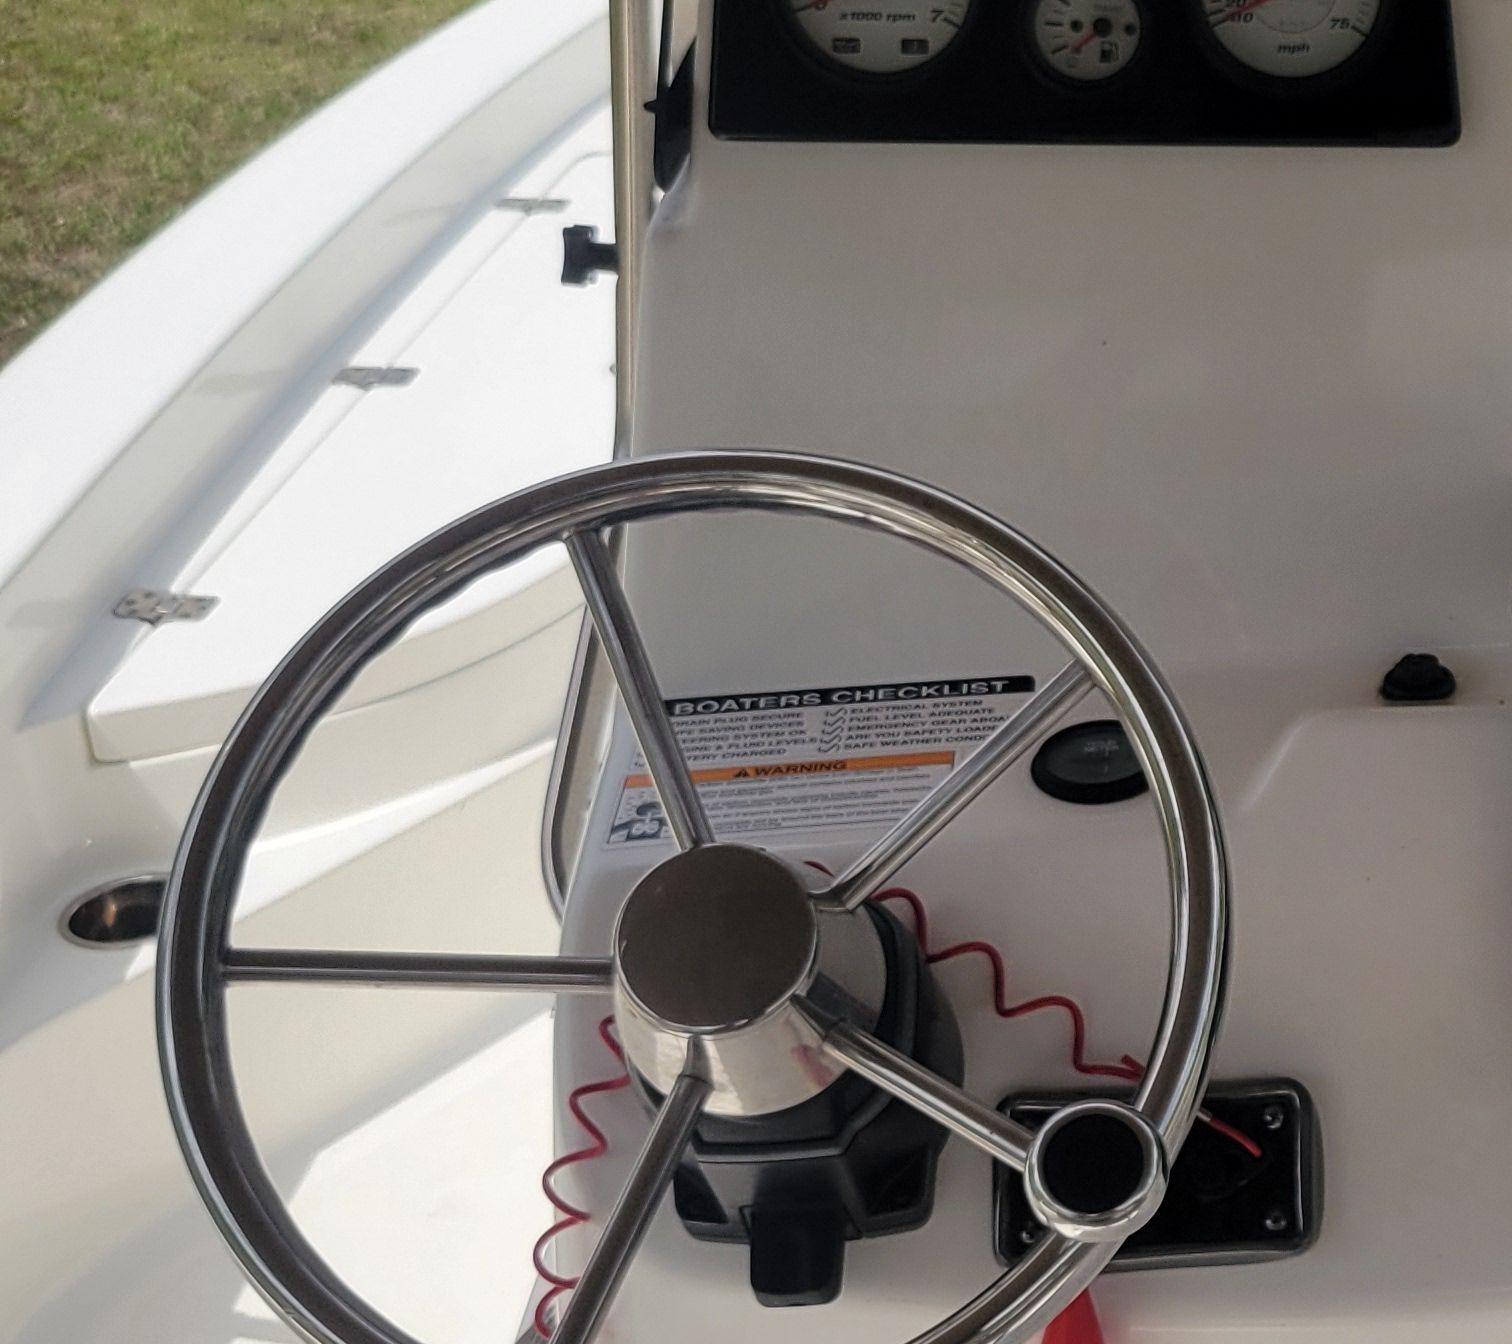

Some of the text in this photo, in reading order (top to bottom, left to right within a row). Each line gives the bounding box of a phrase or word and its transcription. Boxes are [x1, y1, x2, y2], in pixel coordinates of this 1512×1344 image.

[886, 13, 916, 24] rpm
[931, 9, 945, 23] 7
[1330, 18, 1351, 30] 75
[1277, 42, 1310, 56] mph
[674, 680, 1010, 716] BOATERS CHECKLIST
[850, 699, 983, 715] ELECTRICAL SYSTEM
[885, 712, 922, 721] LEVEL
[929, 707, 995, 718] ADEQUATE
[847, 720, 928, 732] EMERGENCY
[931, 717, 967, 726] GEAR
[880, 737, 942, 748] WEATHER
[755, 760, 848, 775] WARNING
